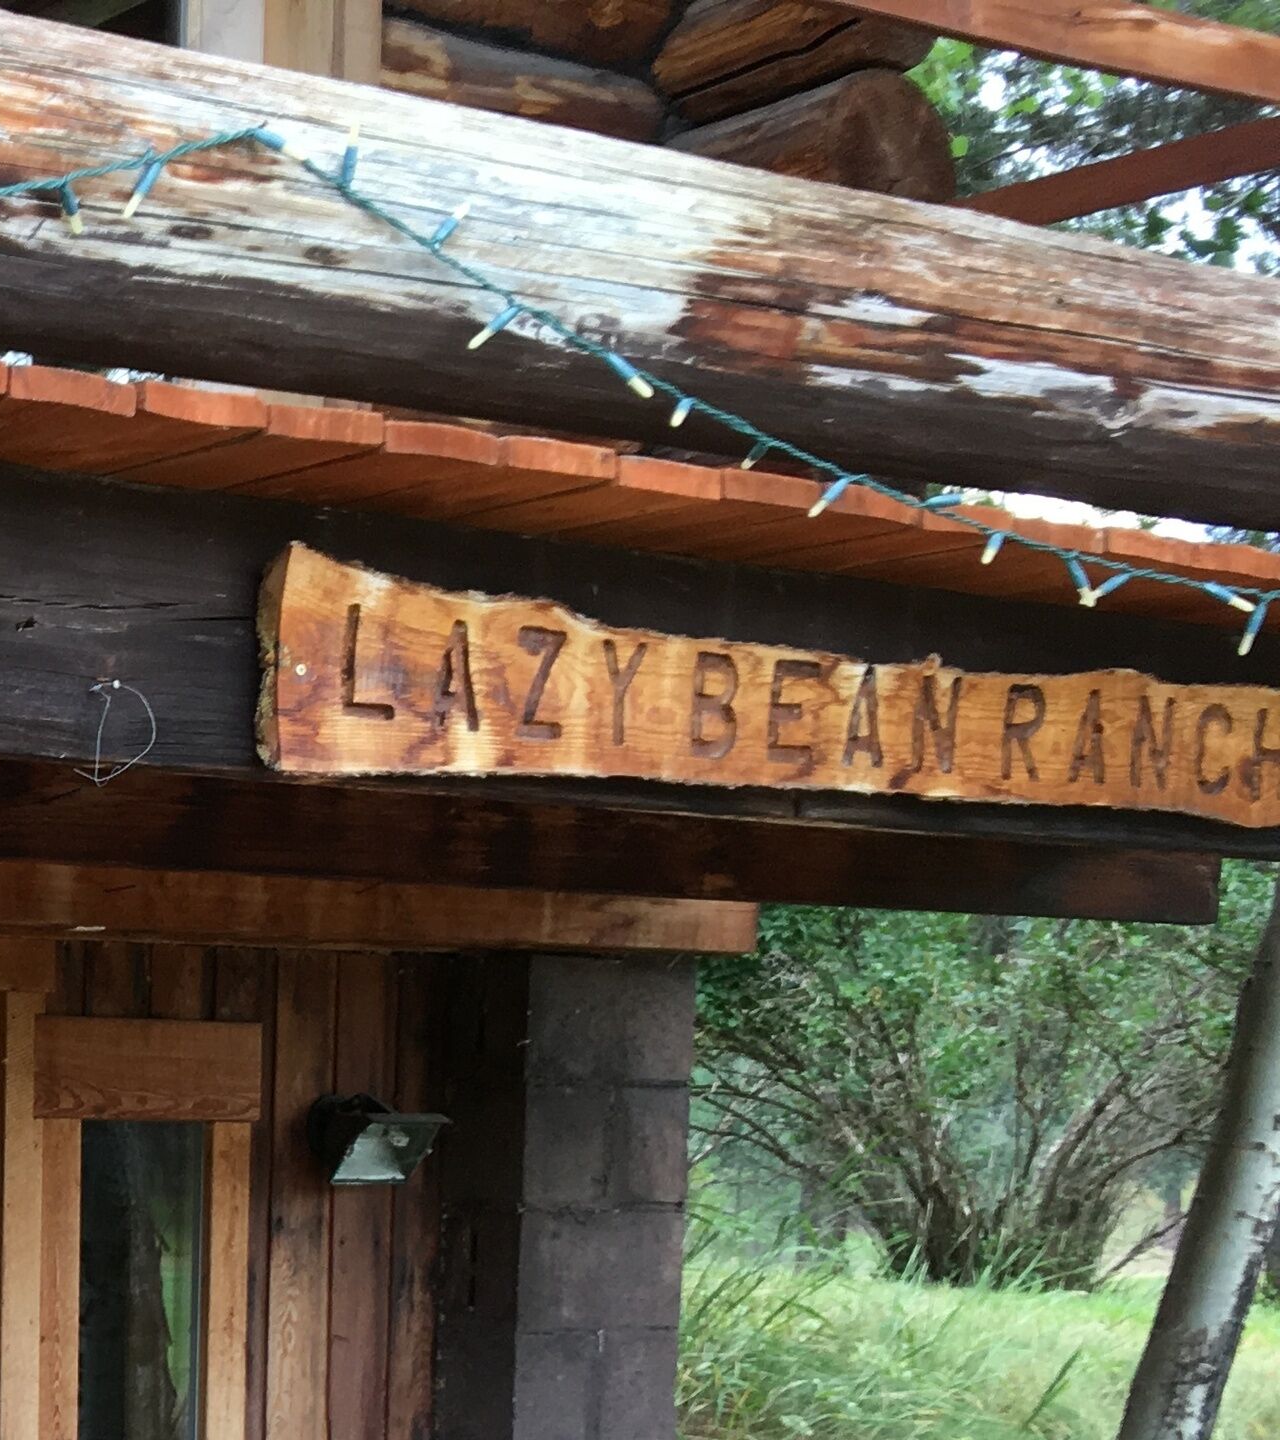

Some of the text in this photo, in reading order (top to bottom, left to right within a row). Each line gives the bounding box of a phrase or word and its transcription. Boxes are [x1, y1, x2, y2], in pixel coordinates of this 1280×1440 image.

[340, 602, 1280, 802] LAZY BEAN RANCH
